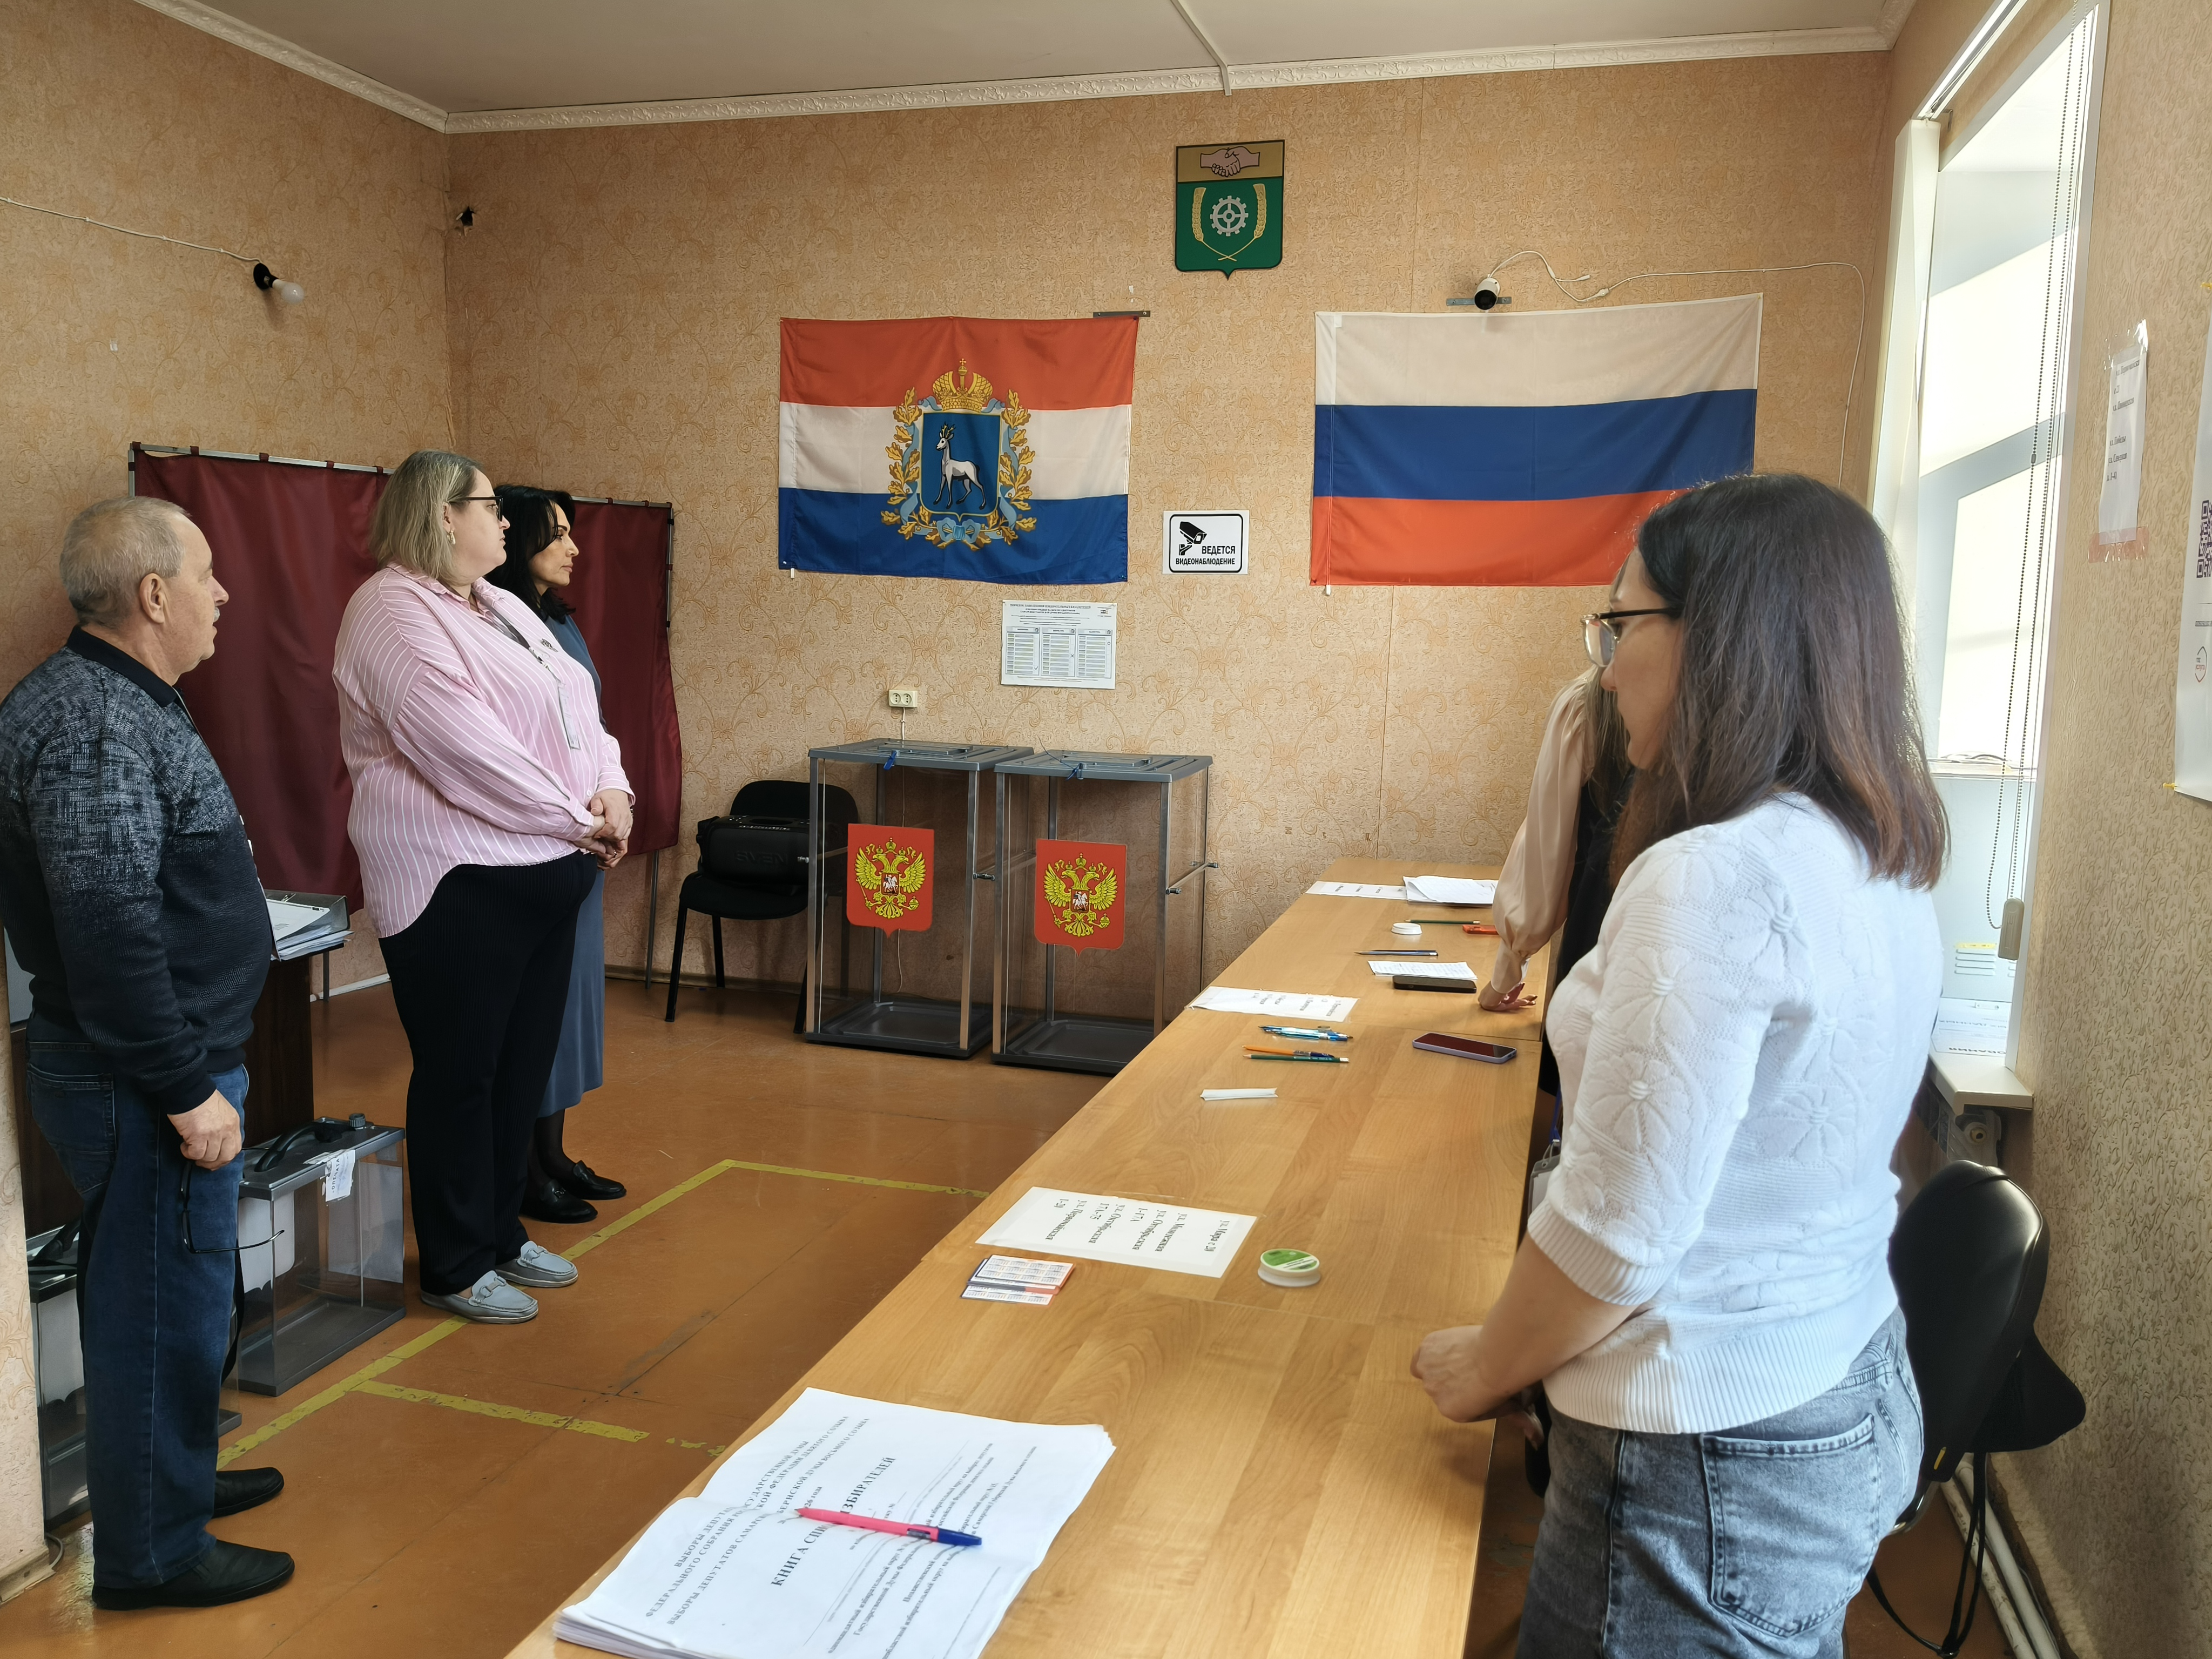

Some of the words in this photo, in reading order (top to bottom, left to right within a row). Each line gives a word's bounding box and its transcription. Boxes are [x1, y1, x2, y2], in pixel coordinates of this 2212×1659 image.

[1176, 558, 1236, 566] ВИДЕОНАБЛЮДЕНИЕ
[1202, 545, 1236, 556] ВЕДЕТСЯ
[1044, 1209, 1084, 1241] Первомайская
[1088, 1213, 1122, 1244] Октябрьская
[1131, 1219, 1164, 1250] Октябрьская
[1209, 1227, 1228, 1242] Мира
[673, 1534, 706, 1568] ВЫБОРЫ
[738, 1454, 793, 1509] СУДАРСТВЕННОЙ
[790, 1441, 810, 1456] ДУМЫ
[810, 1486, 823, 1499] года
[645, 1557, 701, 1617] ФЕДЕРАЛЬНОГО
[698, 1518, 735, 1556] СОБРАНИЯ
[769, 1456, 804, 1489] ФЕДЕРАЦИИ
[666, 1591, 700, 1626] ВЫБОРЫ
[697, 1544, 738, 1591] ДЕПУТАТОВ
[775, 1476, 808, 1514] БЕРНСКОЙ
[804, 1461, 825, 1476] ДУМЫ
[770, 1547, 810, 1587] КНИГА
